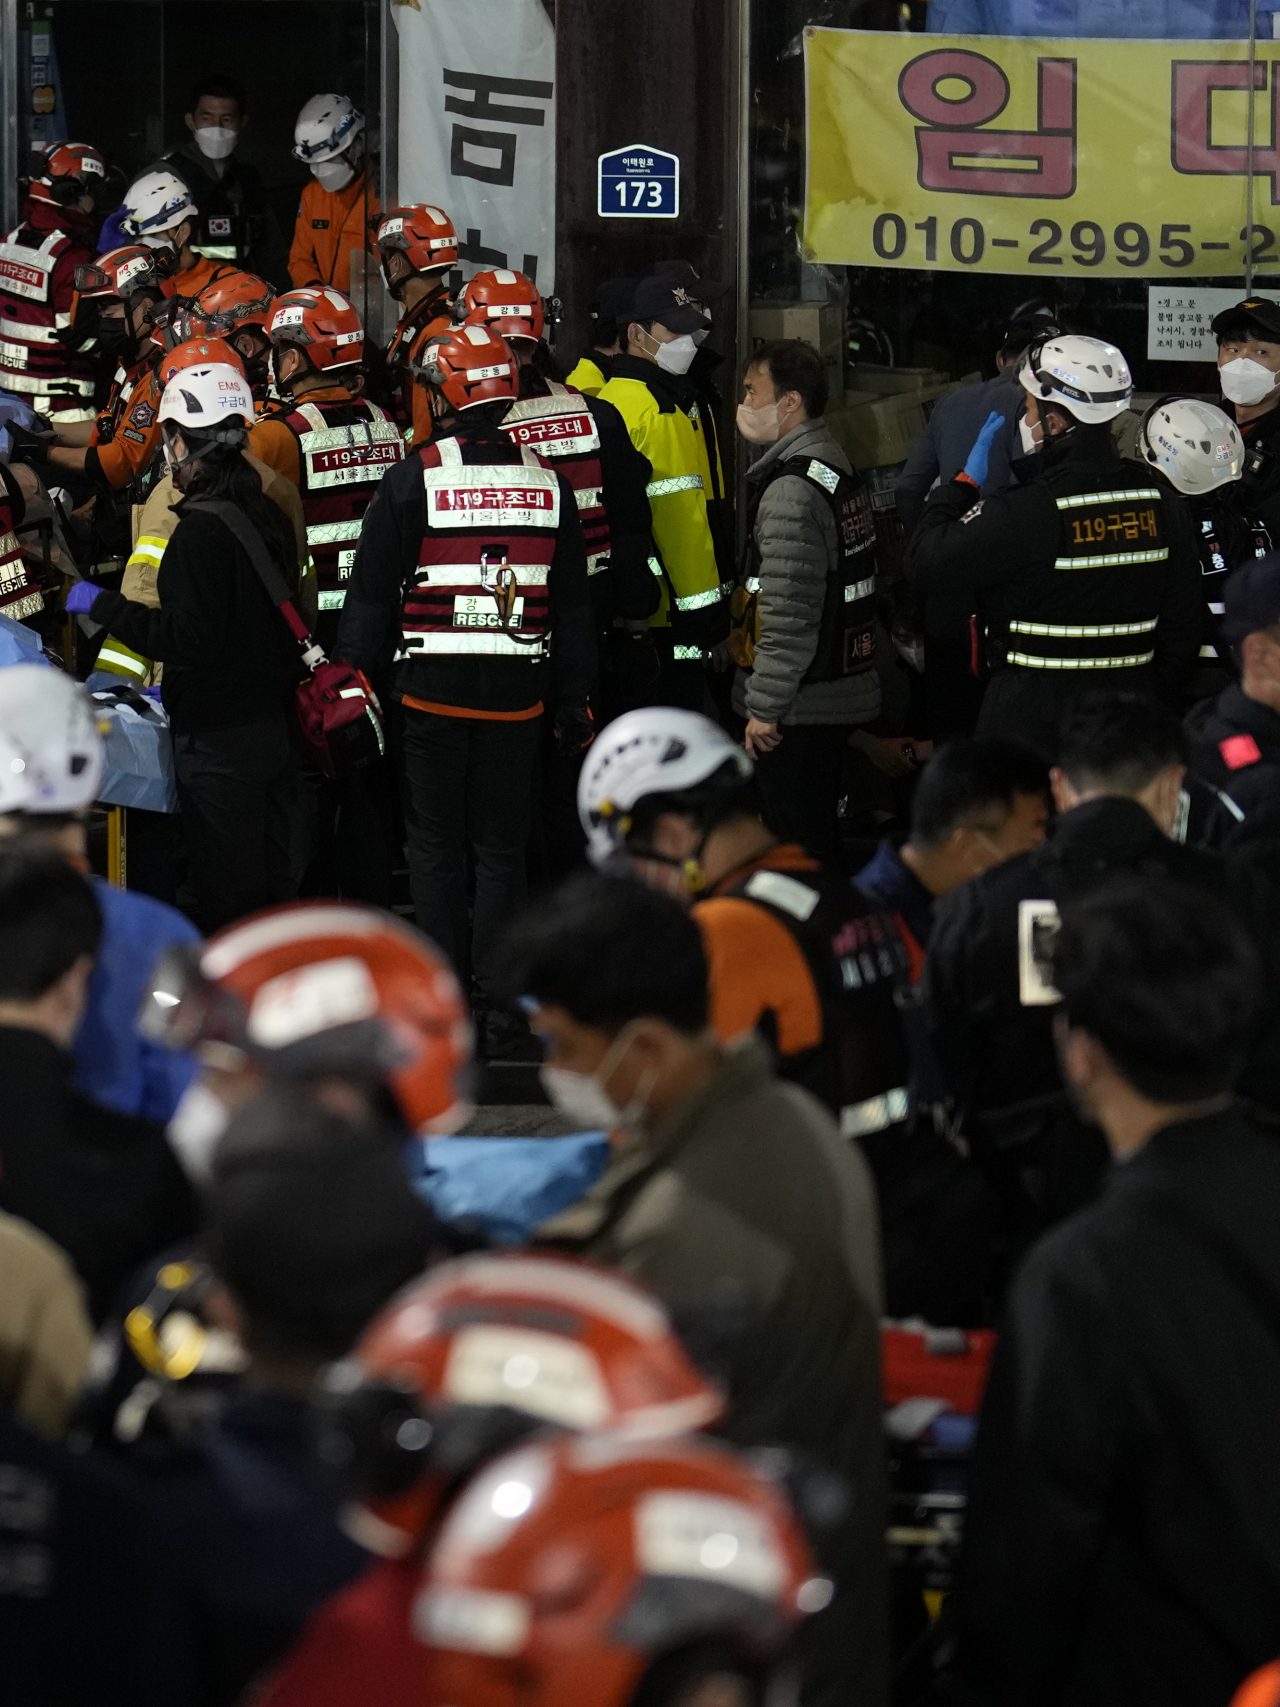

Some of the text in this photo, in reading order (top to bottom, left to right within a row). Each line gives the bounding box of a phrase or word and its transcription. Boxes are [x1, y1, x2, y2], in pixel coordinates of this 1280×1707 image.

[897, 47, 1078, 200] 임
[622, 157, 655, 168] 이태원로
[615, 181, 663, 208] 173
[872, 212, 1280, 269] 010-2995-2
[217, 381, 241, 392] EMS
[217, 396, 248, 409] 구급대
[446, 489, 545, 510] 119구조대
[459, 510, 532, 523] 서울소방
[1071, 509, 1158, 544] 119구급대
[465, 597, 478, 612] 강
